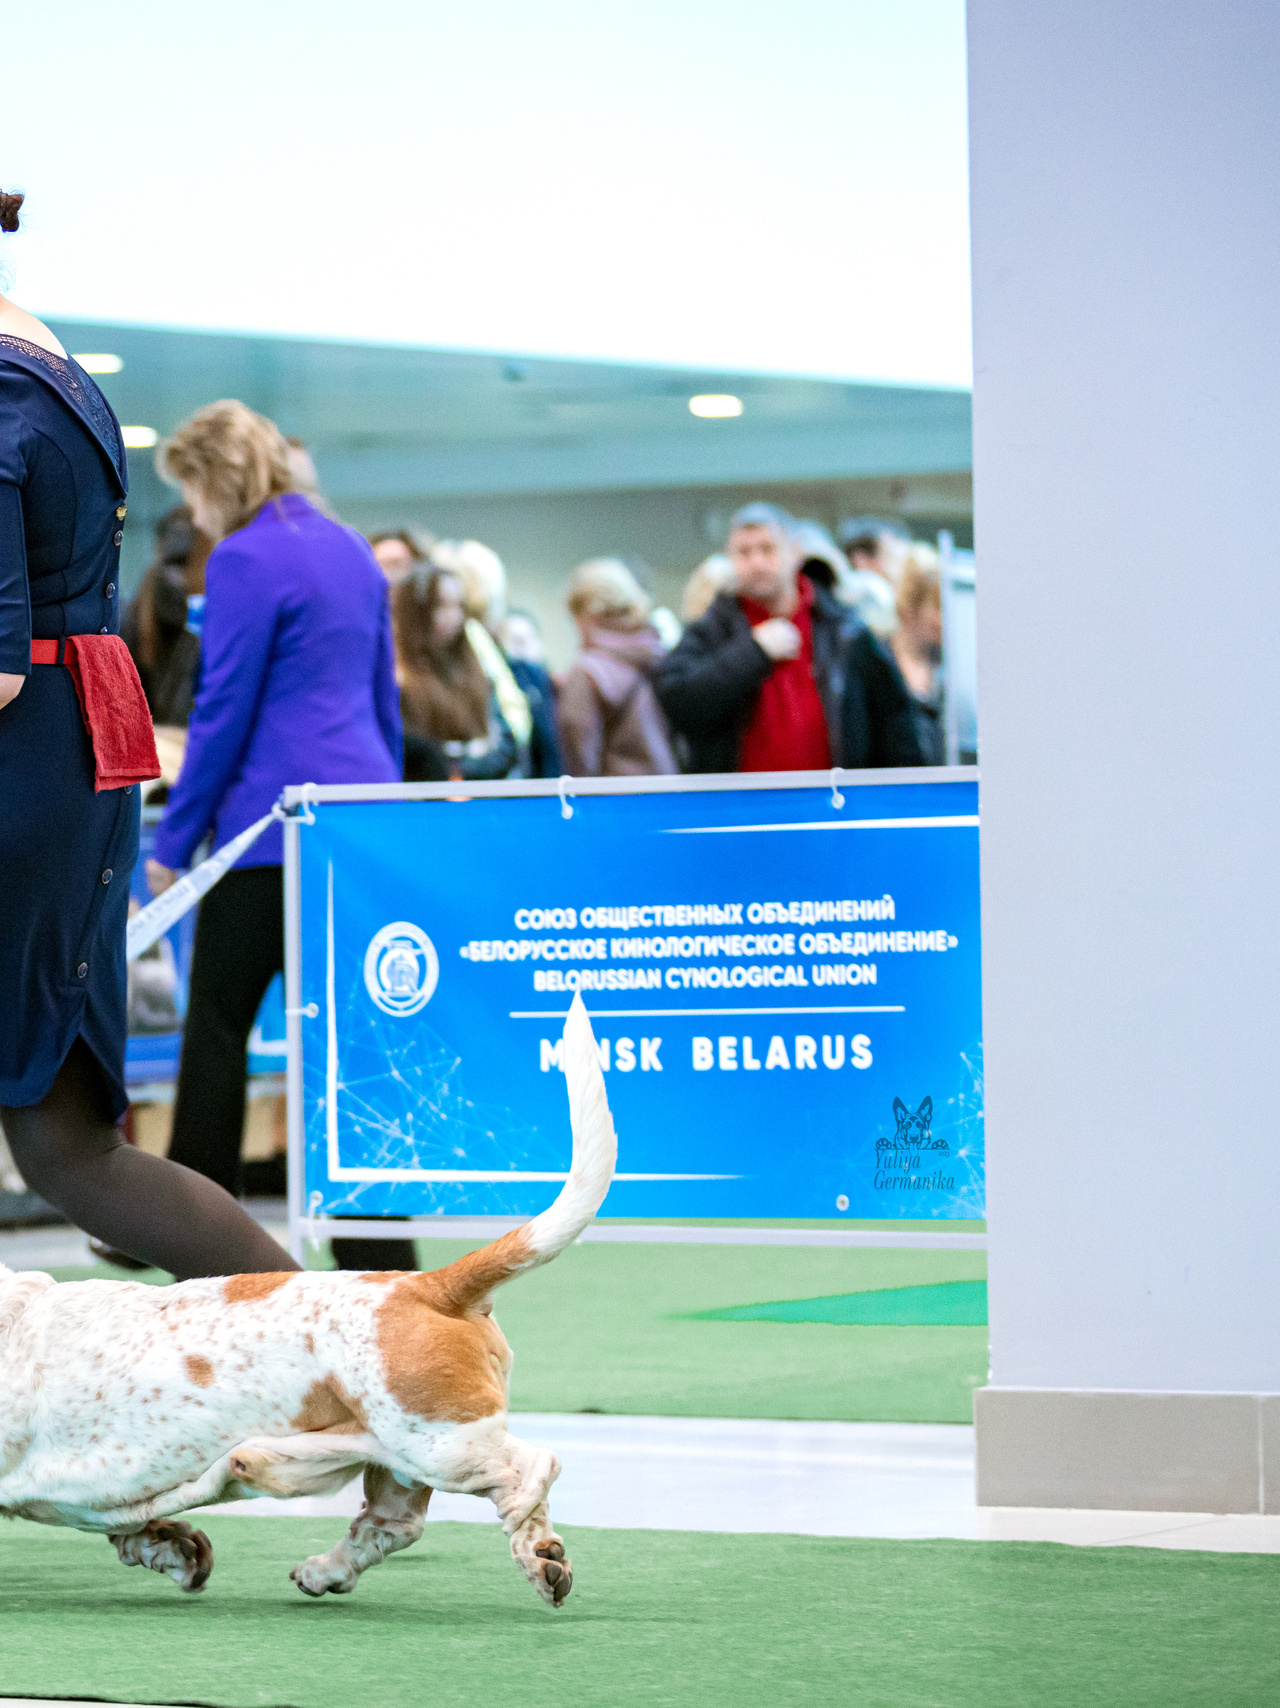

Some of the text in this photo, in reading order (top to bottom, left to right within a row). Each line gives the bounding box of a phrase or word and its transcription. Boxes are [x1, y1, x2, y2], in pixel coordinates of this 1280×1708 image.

[514, 893, 896, 931] СОЮЗ ОБЩЕСТВЕННЫХ ОБЪЕДИНЕНИЙ
[610, 933, 796, 959] КИНОЛОГИЧЕСКОЕ
[533, 963, 878, 992] BELORUSSIAN CYNOLOGICAL UNION
[539, 1033, 874, 1073] MNSK BELARUS
